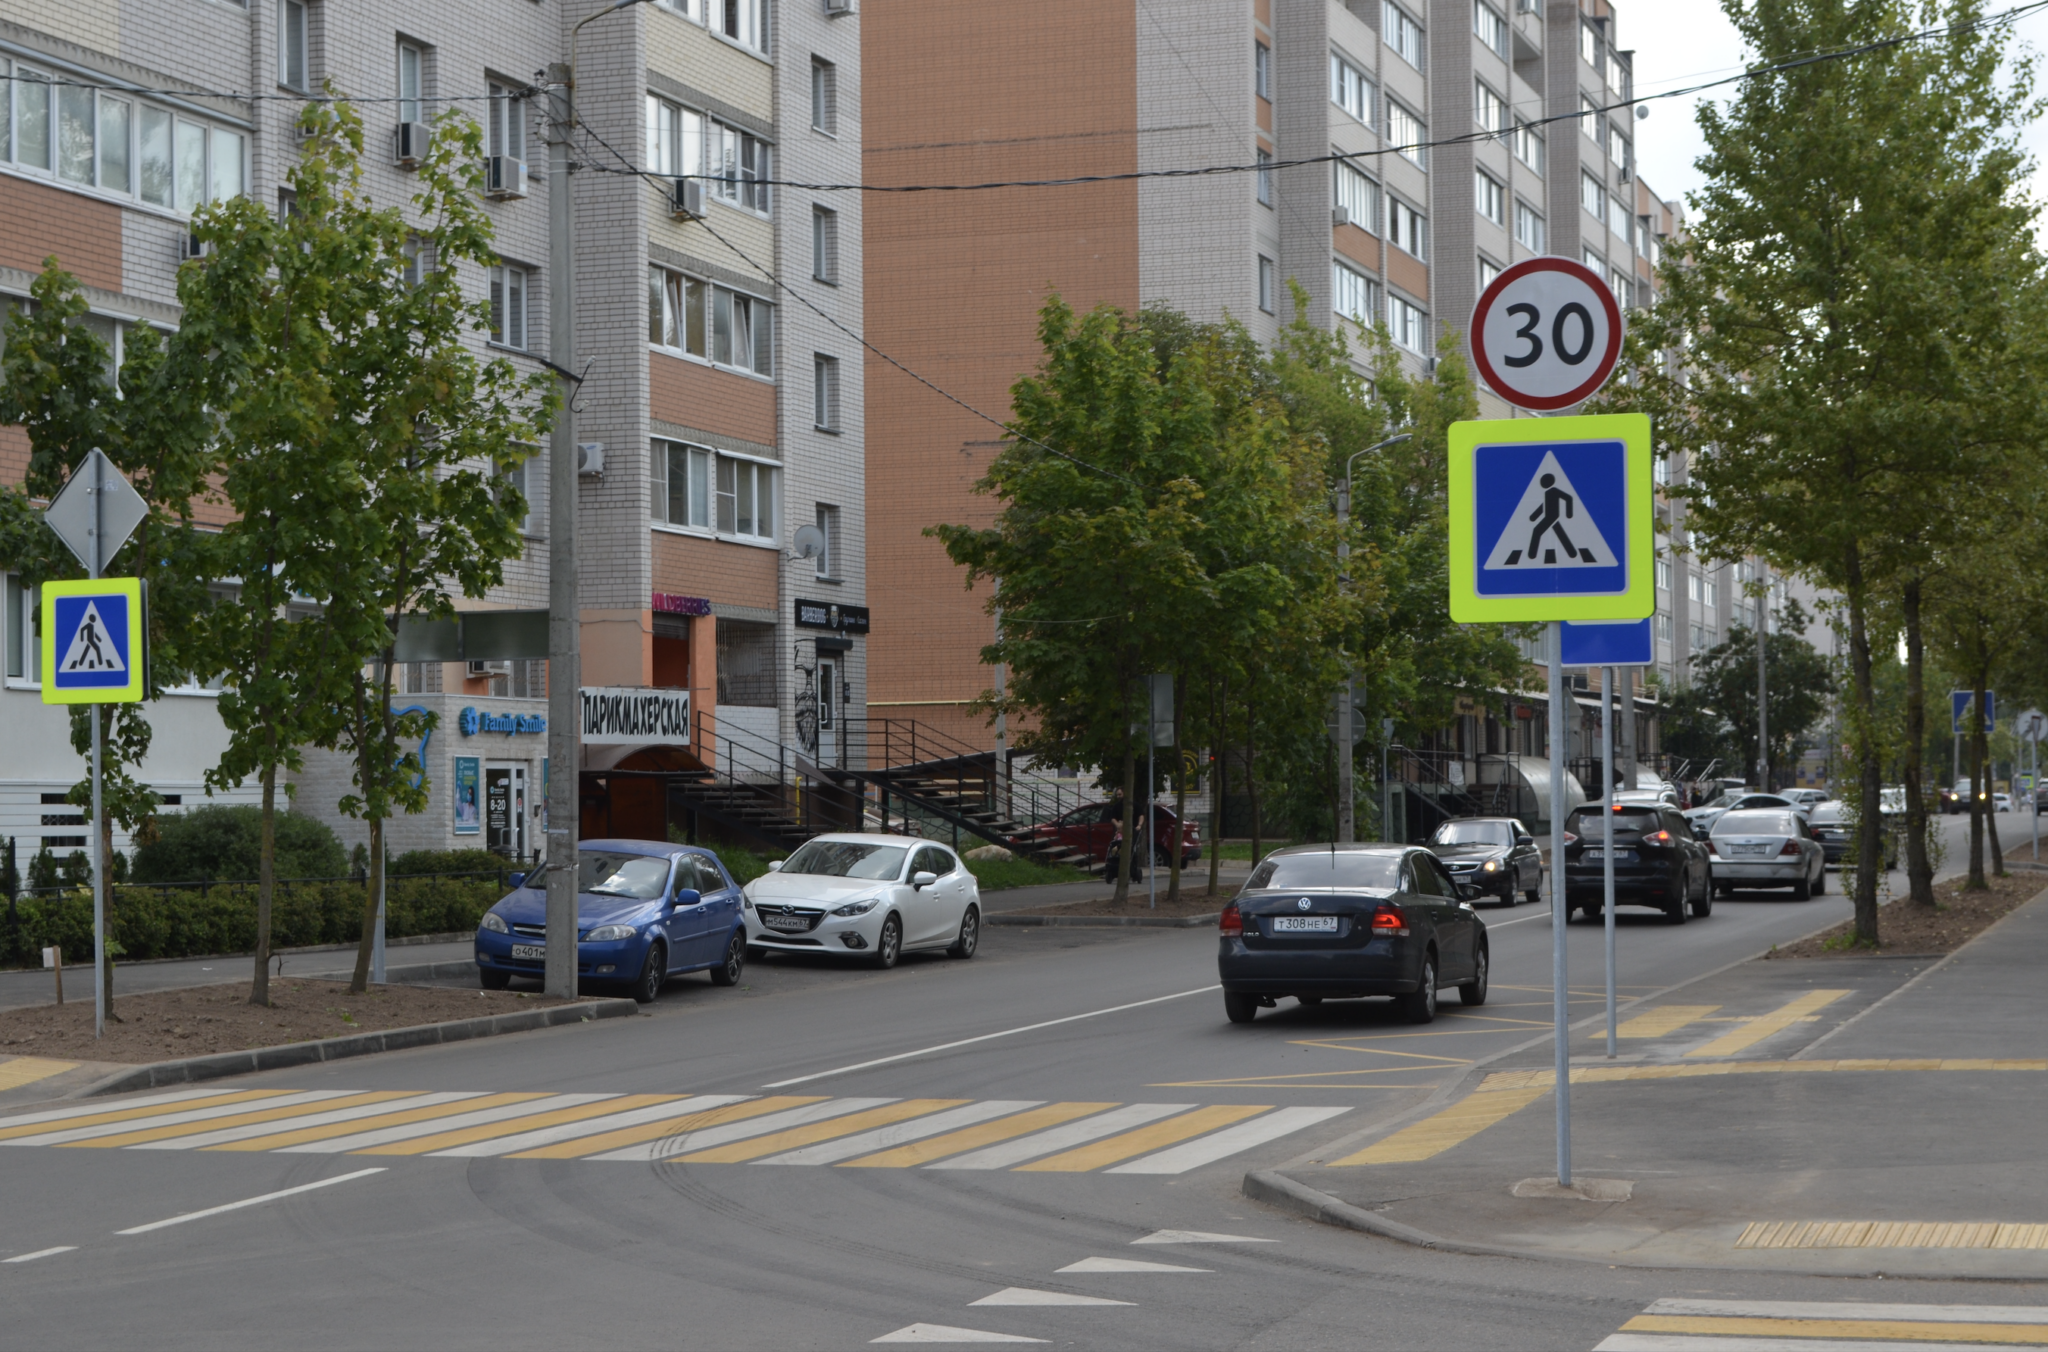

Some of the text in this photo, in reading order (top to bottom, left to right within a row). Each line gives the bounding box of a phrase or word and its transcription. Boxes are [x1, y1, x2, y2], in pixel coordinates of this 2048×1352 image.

[1504, 302, 1594, 368] 30
[652, 592, 711, 615] WILDBERRIES
[482, 711, 547, 736] Family Smile
[583, 694, 689, 738] ПАРИКМАХЕРСКАЯ
[490, 799, 506, 811] 8-20
[1279, 917, 1334, 929] Т308НЕ 67
